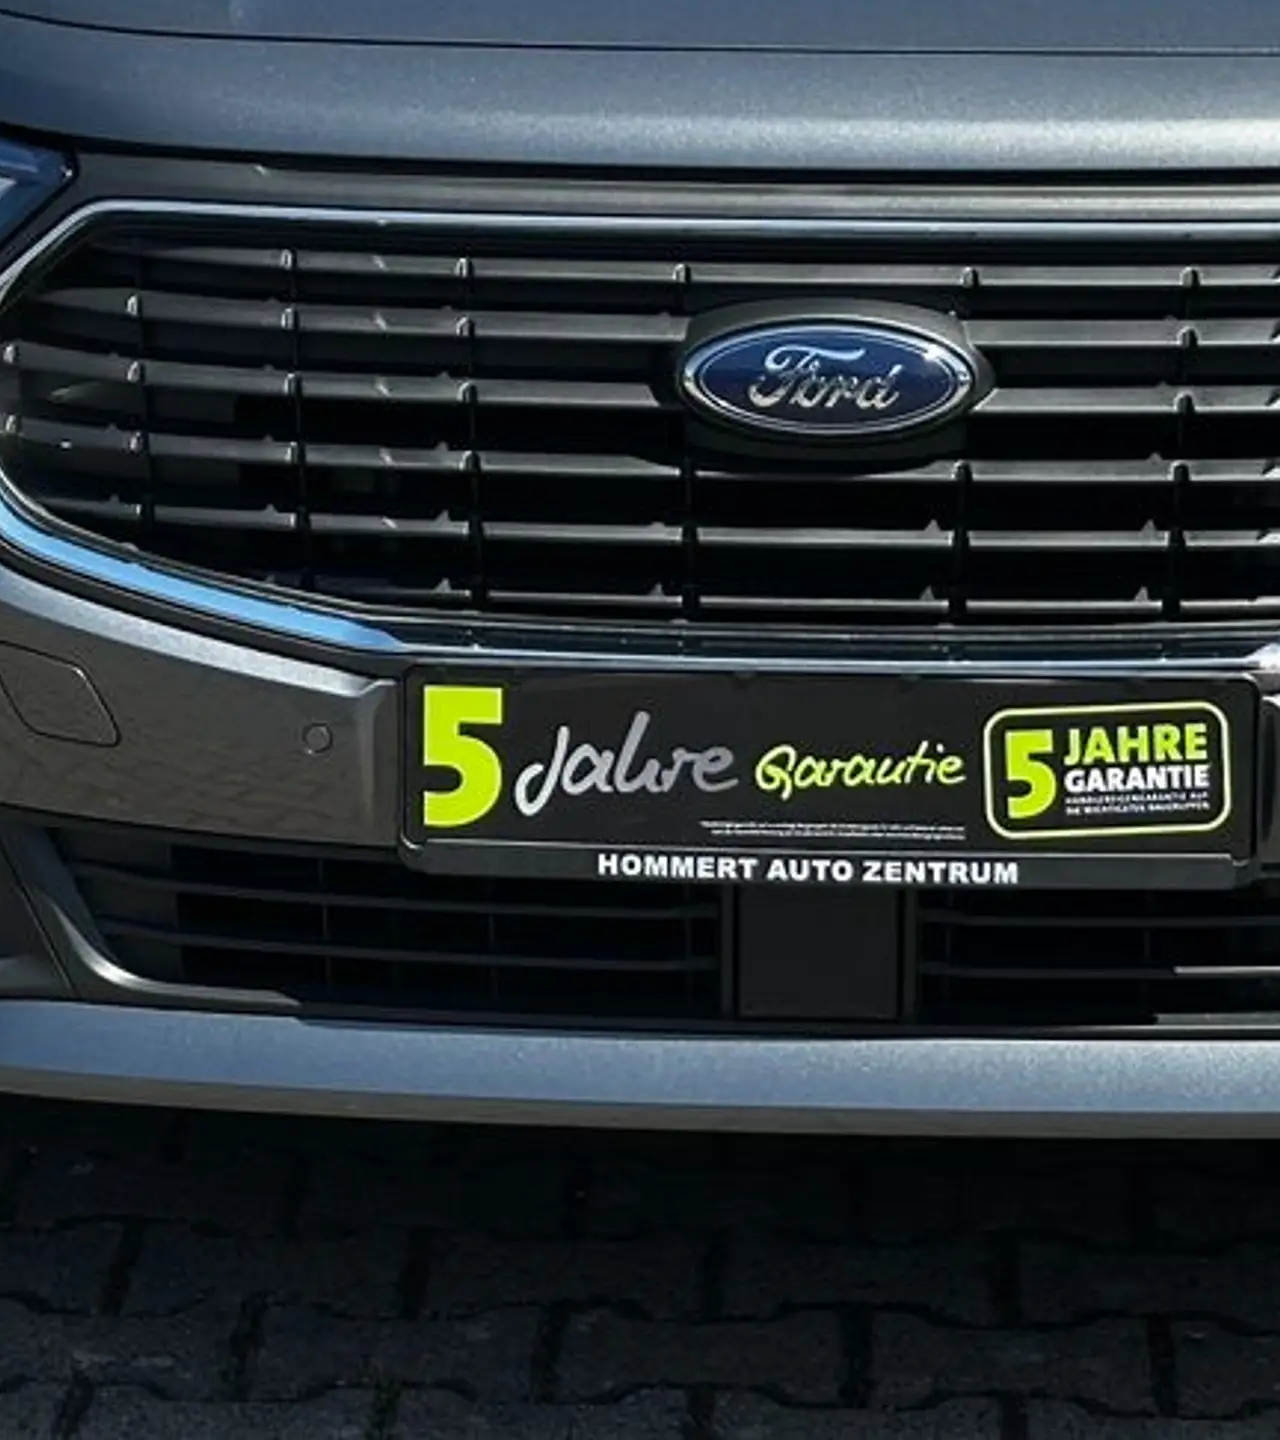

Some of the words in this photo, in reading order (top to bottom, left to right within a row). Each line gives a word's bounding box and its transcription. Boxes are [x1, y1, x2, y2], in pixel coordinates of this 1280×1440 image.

[747, 344, 907, 410] Ford
[423, 685, 502, 827] 5
[514, 710, 740, 817] Jahre
[1004, 728, 1057, 819] 5
[1063, 722, 1208, 766] JAHRE
[1064, 764, 1210, 793] GARANTIE
[597, 853, 758, 880] HOMMERT
[766, 859, 852, 882] AUTO
[862, 861, 1019, 885] ZENTRUM
